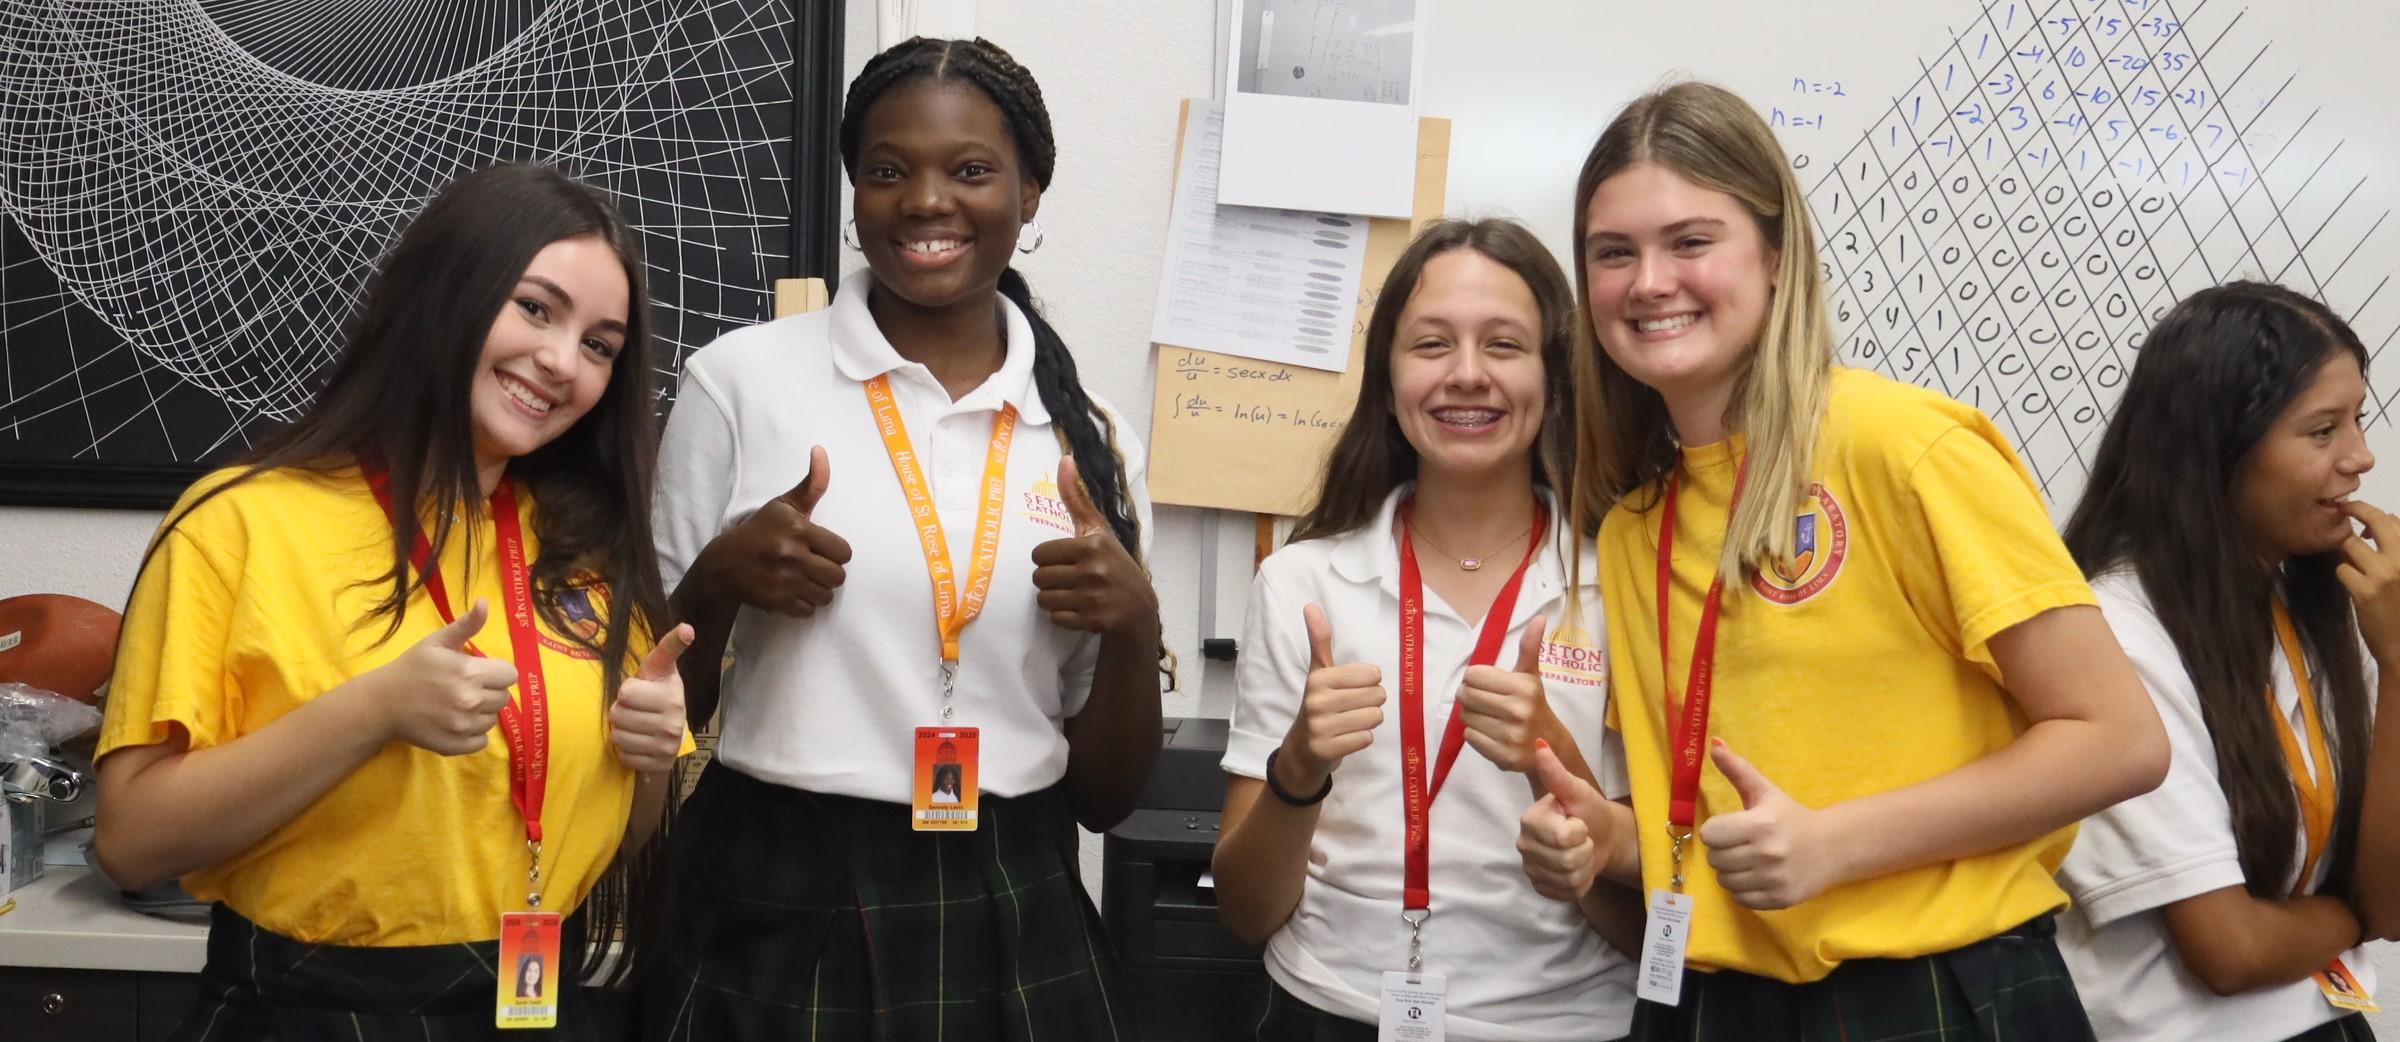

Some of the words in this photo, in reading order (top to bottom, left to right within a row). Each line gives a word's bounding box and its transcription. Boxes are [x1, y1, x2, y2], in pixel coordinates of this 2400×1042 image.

[2006, 4, 2014, 30] 1
[2048, 18, 2077, 36] -5
[2096, 16, 2122, 36] 15
[2142, 18, 2180, 38] -35
[1977, 33, 1988, 60] 1
[2017, 45, 2044, 64] -4
[2064, 46, 2086, 68] 10
[2109, 54, 2149, 71] -20
[2163, 52, 2190, 71] 35
[1793, 78, 1807, 94] n
[1945, 64, 1954, 91] 1
[1988, 73, 2014, 96] -3
[2042, 80, 2055, 100] 6
[2075, 86, 2111, 104] -10
[2131, 85, 2161, 106] 15
[2175, 89, 2205, 109] -21
[1770, 106, 1785, 127] n
[1912, 96, 1921, 126] 1
[1956, 103, 1985, 125] -2
[2008, 106, 2028, 131] 3
[2053, 113, 2084, 136] -4
[2106, 120, 2129, 141] 5
[2149, 124, 2178, 141] -6
[2207, 124, 2223, 148] 7
[1931, 135, 1953, 157] -1
[2027, 147, 2048, 168] -1
[2119, 158, 2142, 177] -1
[2223, 167, 2247, 187] -1
[1904, 171, 1917, 190] 0
[1953, 176, 1968, 194] 0
[2000, 178, 2017, 195] 0
[2045, 185, 2064, 205] 0
[2092, 189, 2113, 208] 0
[2141, 197, 2165, 213] 0
[1922, 208, 1938, 224] 0
[1973, 213, 1992, 229] 0
[2018, 215, 2039, 233] 0
[2063, 216, 2087, 237] 0
[2116, 229, 2136, 247] 0
[1845, 231, 1859, 255] 2
[1943, 247, 1960, 265] 0
[1992, 249, 2014, 267] 0
[2041, 251, 2059, 268] 0
[2087, 254, 2108, 275] 0
[2135, 266, 2156, 280] 0
[1863, 271, 1874, 293] 3
[1959, 281, 1978, 300] 0
[2011, 286, 2030, 303] 0
[2055, 289, 2077, 307] 0
[2107, 293, 2127, 318] 0
[1838, 300, 1850, 323] 6
[1886, 307, 1899, 330] 4
[1976, 317, 2000, 342] 0
[2076, 331, 2100, 350] 0
[1852, 337, 1876, 359] 10
[1903, 347, 1921, 371] 5
[1998, 354, 2024, 375] 0
[2050, 365, 2073, 381] 0
[2097, 365, 2123, 388] 0
[876, 405, 897, 436] Lima
[2022, 393, 2049, 414] 0
[2074, 406, 2095, 423] 0
[896, 450, 917, 485] House
[1024, 492, 1067, 513] SETO
[922, 524, 940, 558] Rose
[932, 561, 949, 574] of
[938, 580, 952, 618] Lima
[1538, 641, 1603, 663] SETON
